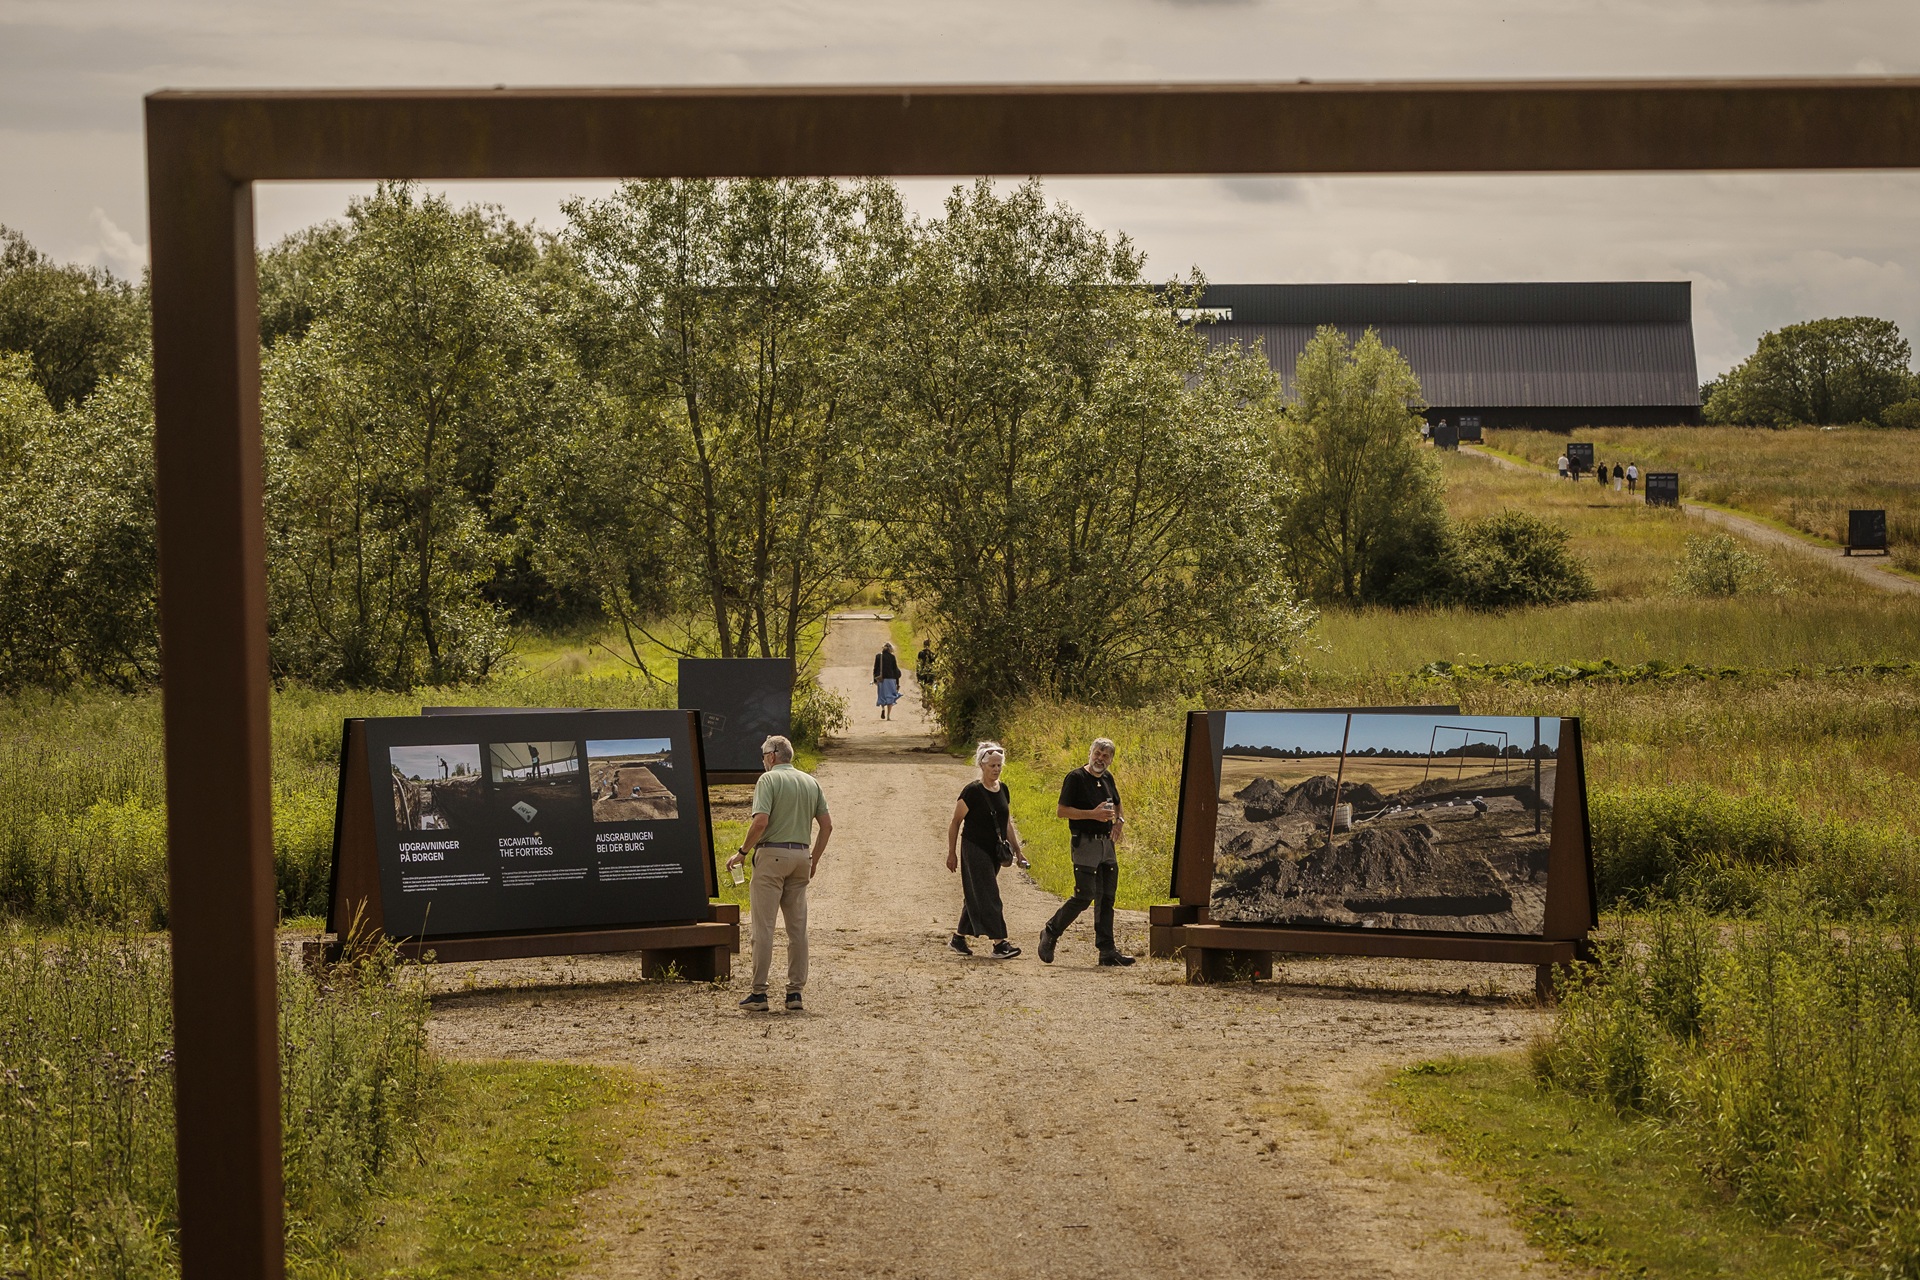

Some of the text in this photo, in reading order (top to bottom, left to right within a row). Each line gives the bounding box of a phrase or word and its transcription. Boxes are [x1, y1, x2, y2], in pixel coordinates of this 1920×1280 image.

[498, 837, 543, 847] EXCAVATING
[596, 831, 654, 842] AUSGRABUNGEN
[399, 840, 460, 851] UDGRAVNINGER
[597, 842, 645, 853] BEI DER BURG
[400, 852, 444, 862] PÅ BORGEN
[500, 846, 553, 857] THE FORTRESS
